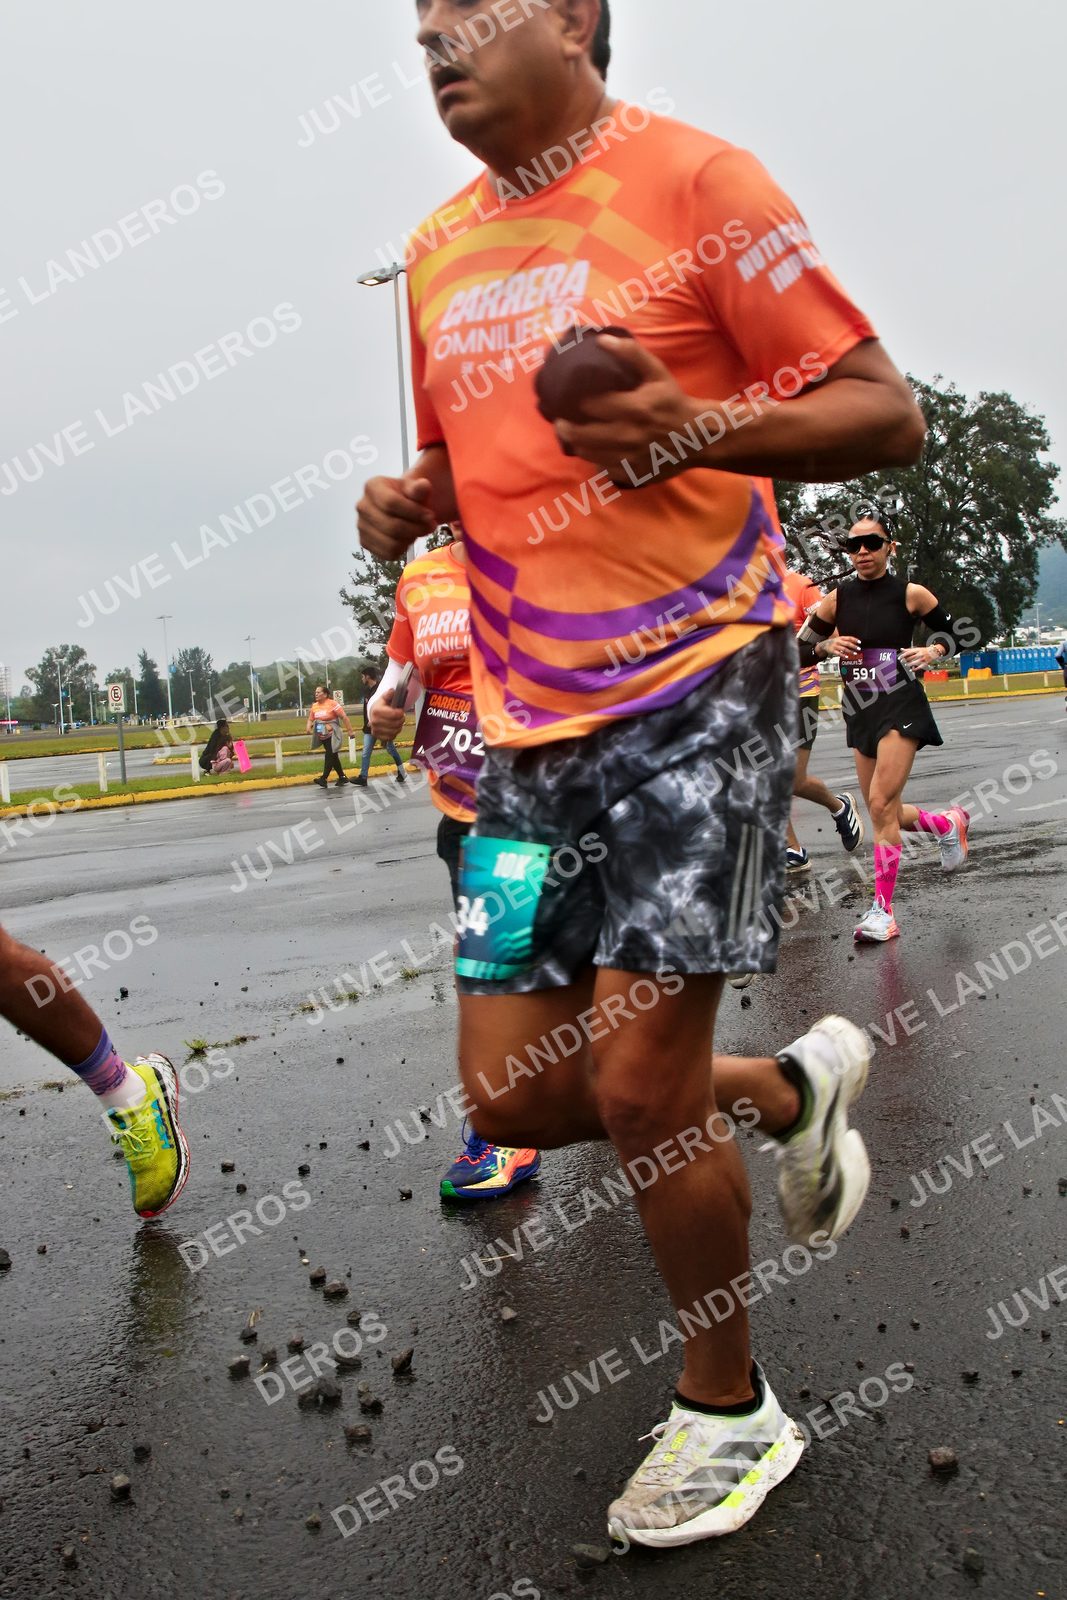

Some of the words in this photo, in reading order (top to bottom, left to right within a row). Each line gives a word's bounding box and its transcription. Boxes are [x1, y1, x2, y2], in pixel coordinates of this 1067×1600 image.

[439, 260, 590, 331] CARRERA
[416, 608, 471, 639] CARR
[416, 636, 472, 657] OMNILI
[852, 667, 876, 680] 591
[429, 694, 472, 713] CARRERA
[441, 725, 485, 756] 702
